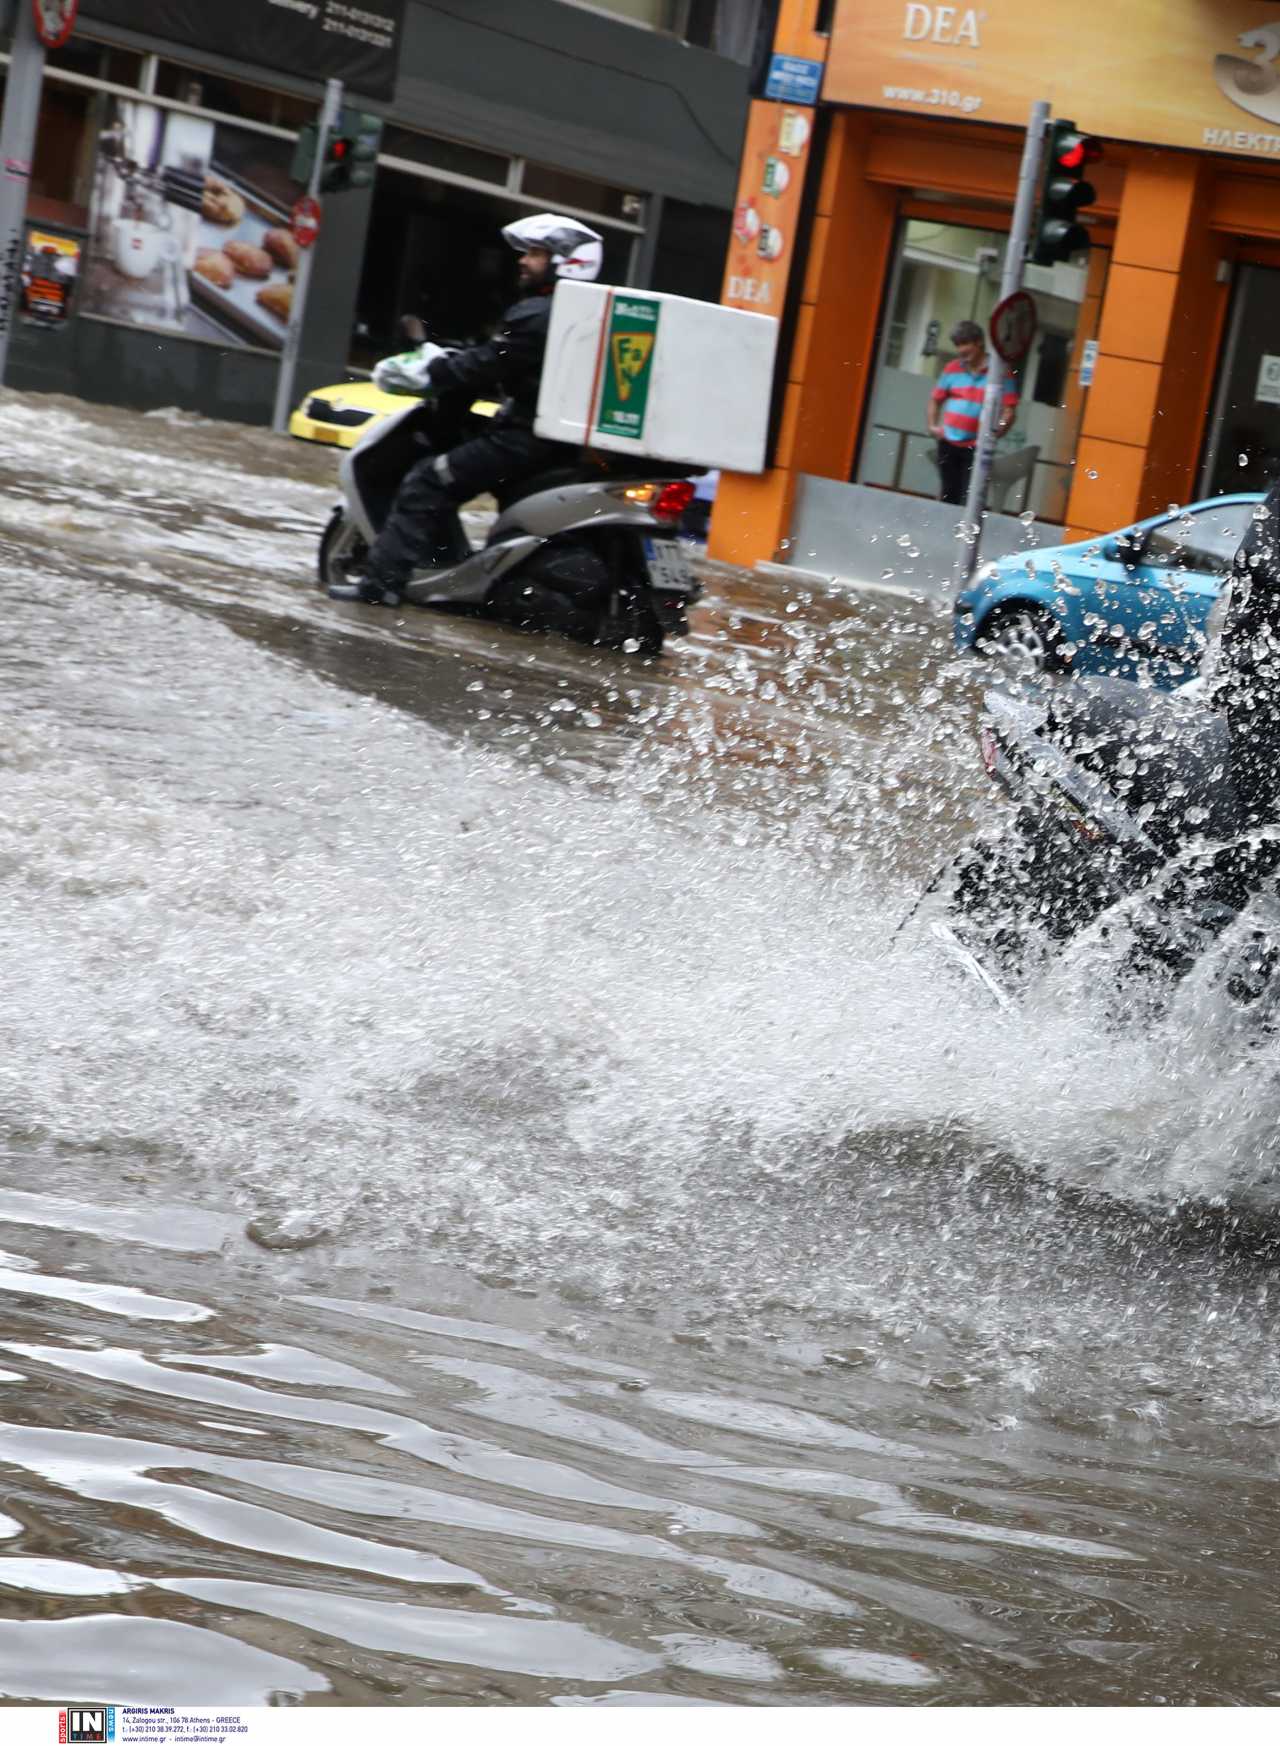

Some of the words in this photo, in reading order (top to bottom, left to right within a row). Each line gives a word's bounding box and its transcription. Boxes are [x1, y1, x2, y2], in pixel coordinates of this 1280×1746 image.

[903, 2, 981, 49] DEA
[882, 85, 984, 113] www.310.gr
[726, 275, 772, 305] DEA
